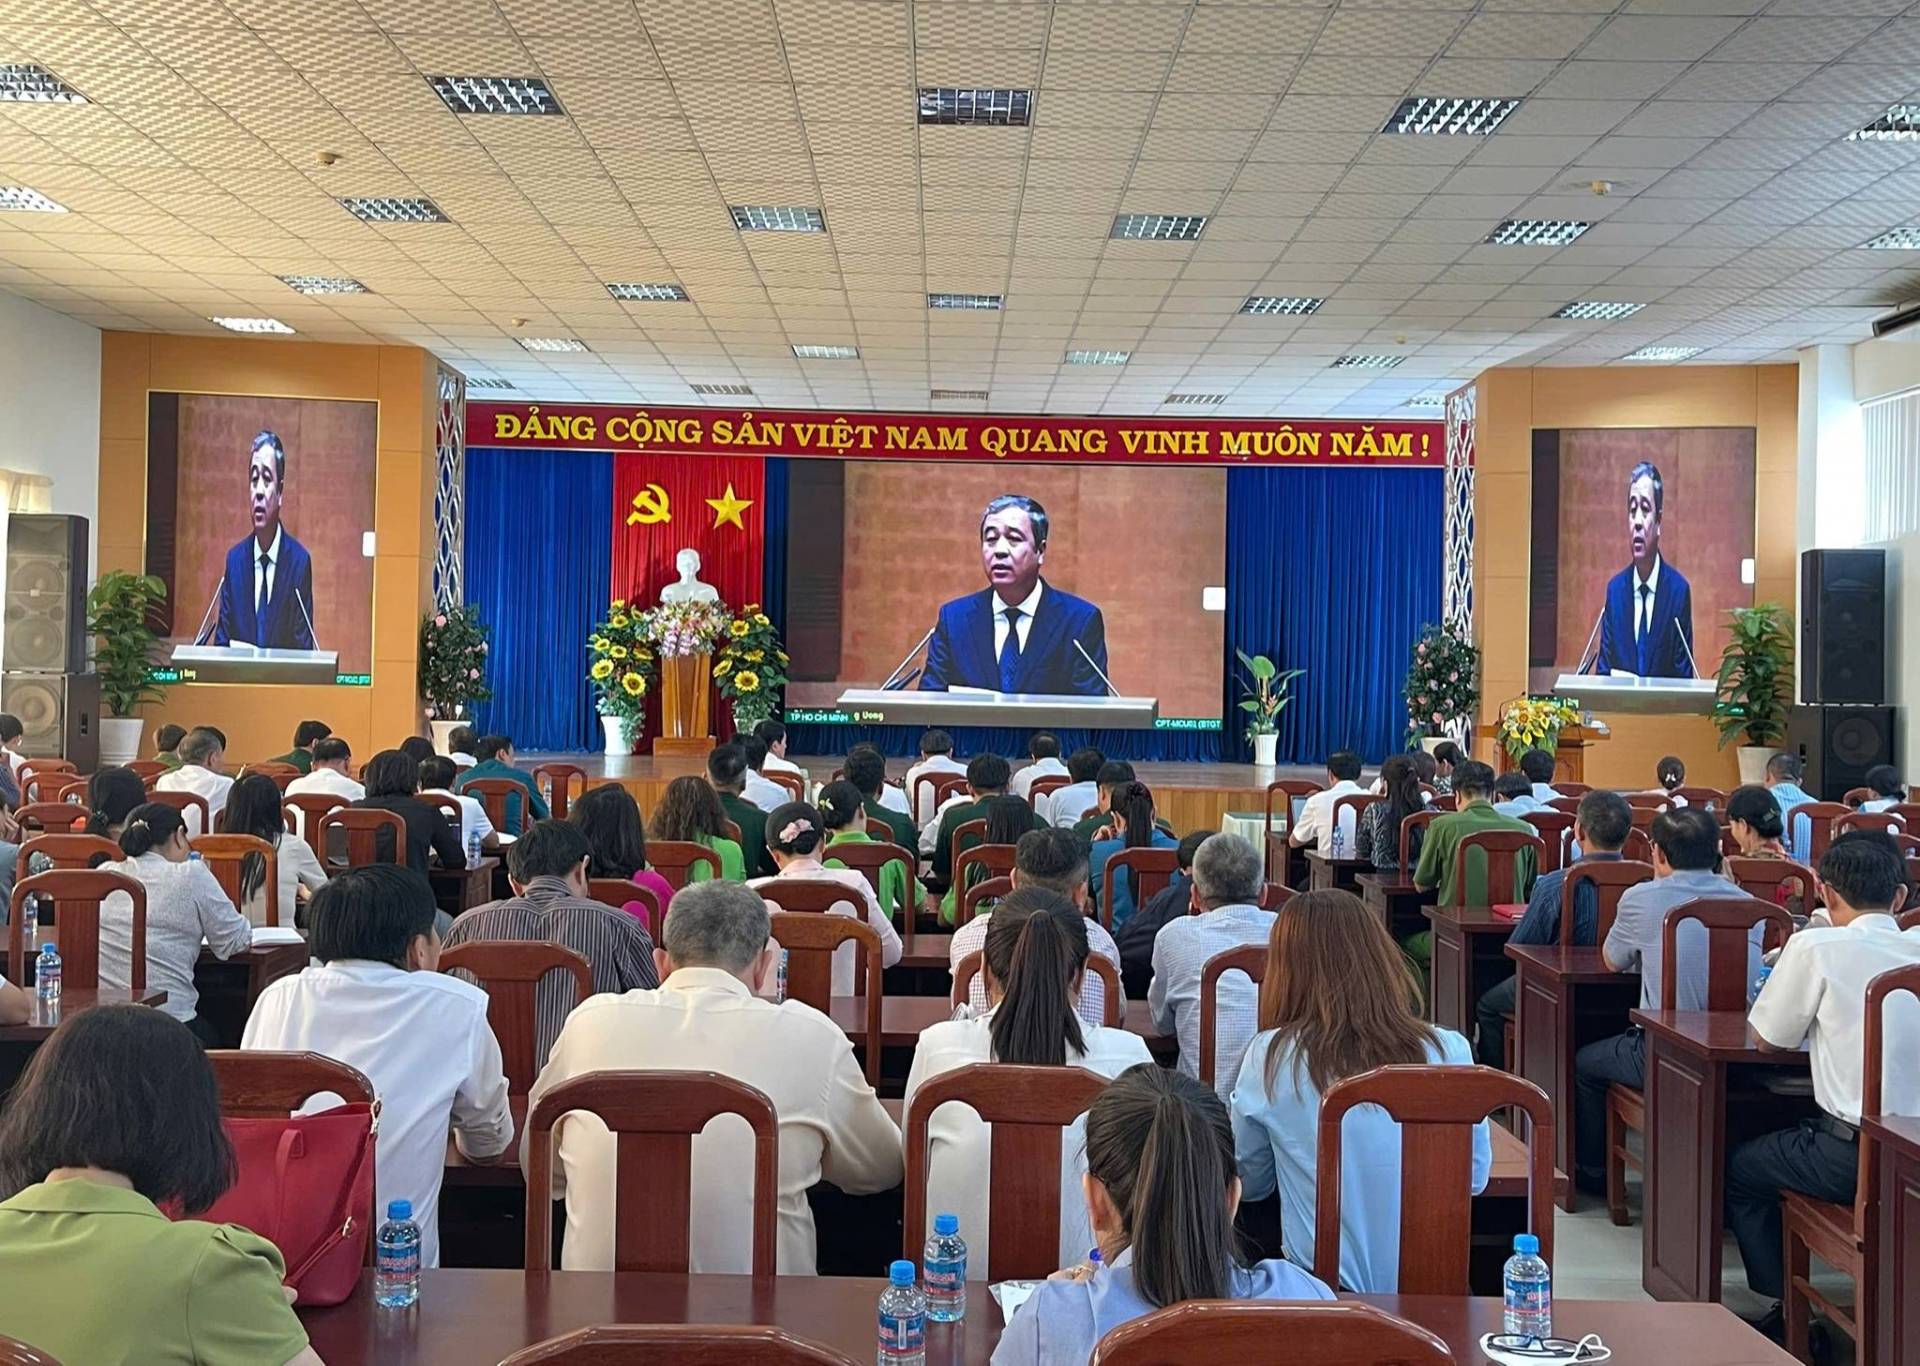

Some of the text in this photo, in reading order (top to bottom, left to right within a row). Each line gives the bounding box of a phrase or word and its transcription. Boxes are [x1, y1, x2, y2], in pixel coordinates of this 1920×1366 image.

[495, 406, 1430, 458] ĐẢNG CỘNG SẢN VIỆT NAM QUANG VINH MUÔN NĂM !
